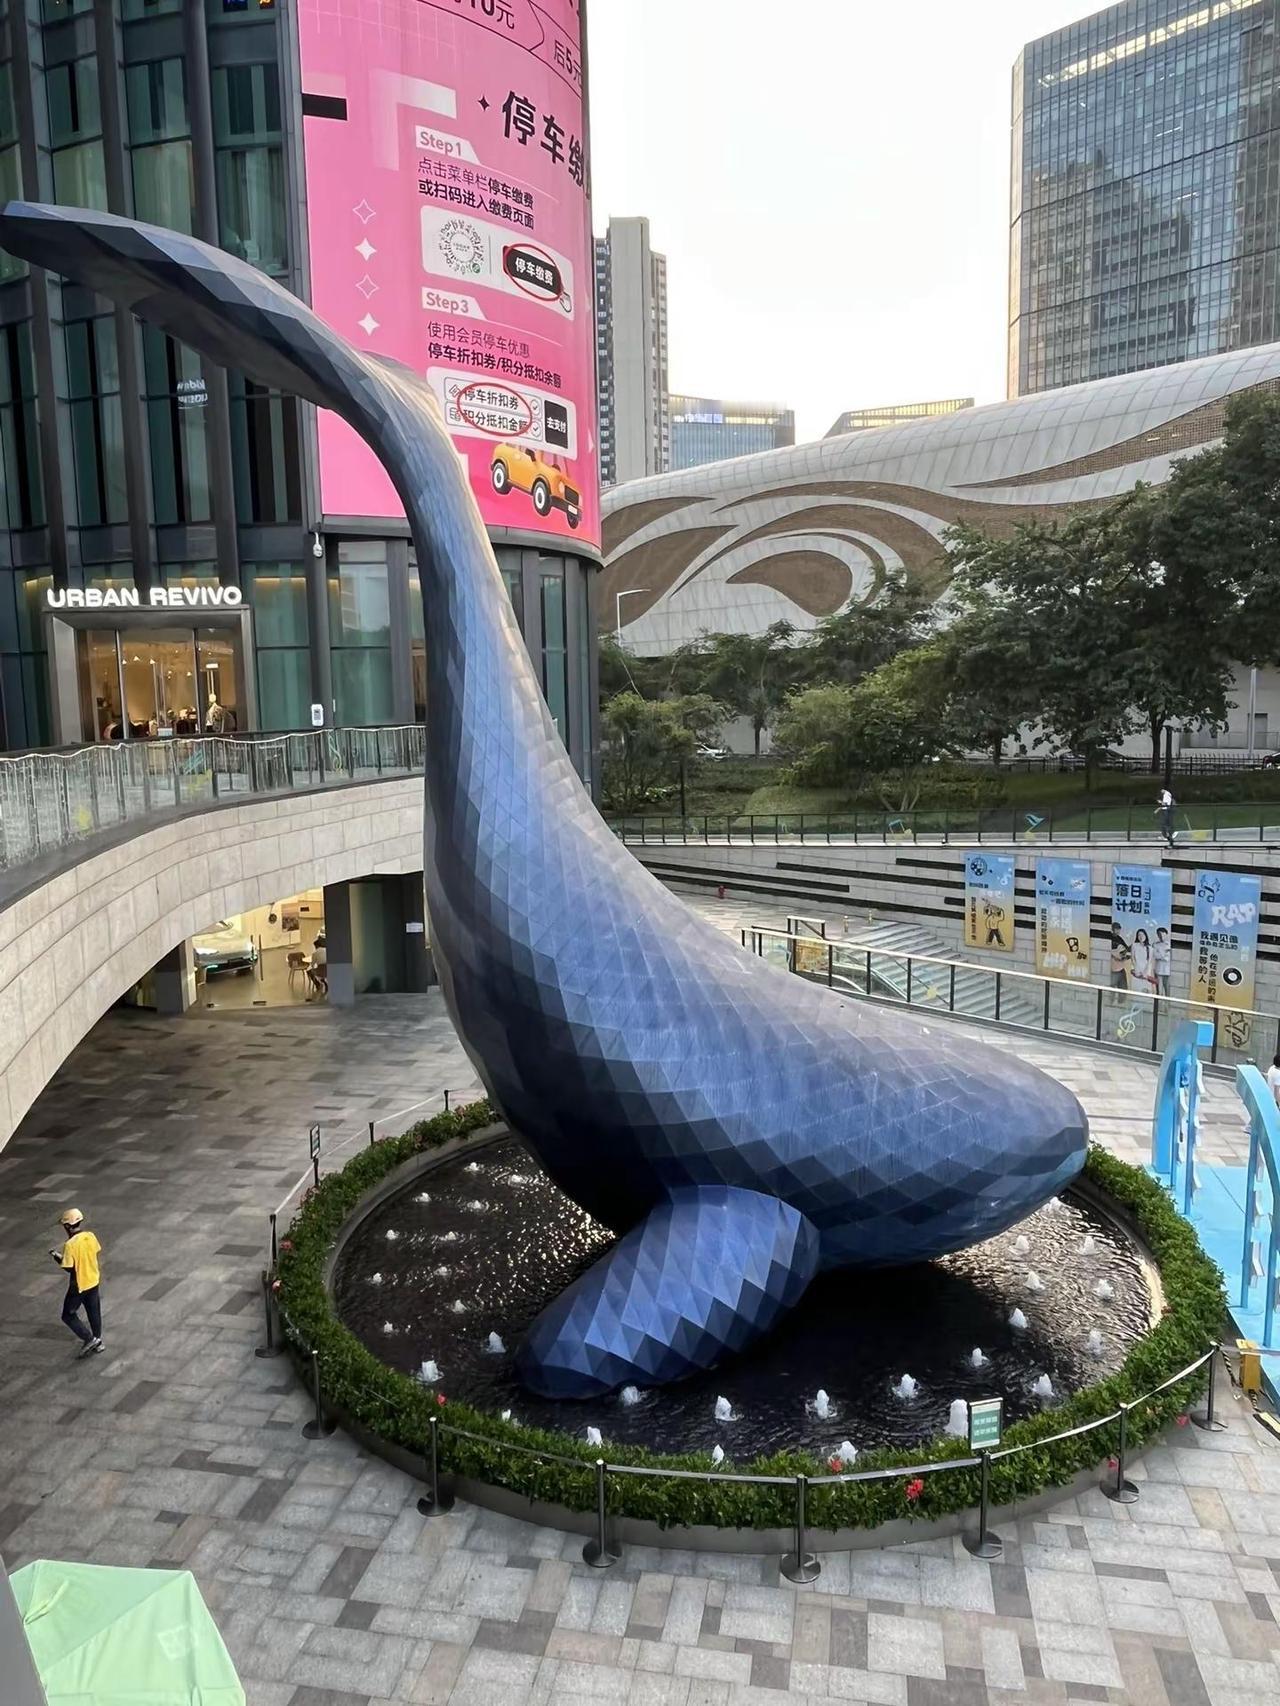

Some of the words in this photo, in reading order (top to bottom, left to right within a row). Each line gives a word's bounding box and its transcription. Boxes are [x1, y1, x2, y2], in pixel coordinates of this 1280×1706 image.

[420, 131, 461, 156] Step1
[418, 157, 534, 210] 点击菜单栏停车缴费
[418, 178, 535, 230] 或扫码进入缴费页面
[515, 257, 554, 286] 停车缴费
[426, 291, 469, 314] Step3
[427, 320, 530, 358] 使用会员停车优惠
[428, 342, 562, 389] 停车折扣券/积分抵扣余额
[463, 388, 519, 411] 停车折扣券
[546, 416, 567, 434] 去支付
[47, 587, 139, 608] URBAN
[150, 585, 242, 606] REVIVO
[1115, 883, 1142, 899] 落日
[1115, 899, 1142, 914] 计划
[1211, 902, 1256, 928] RAP
